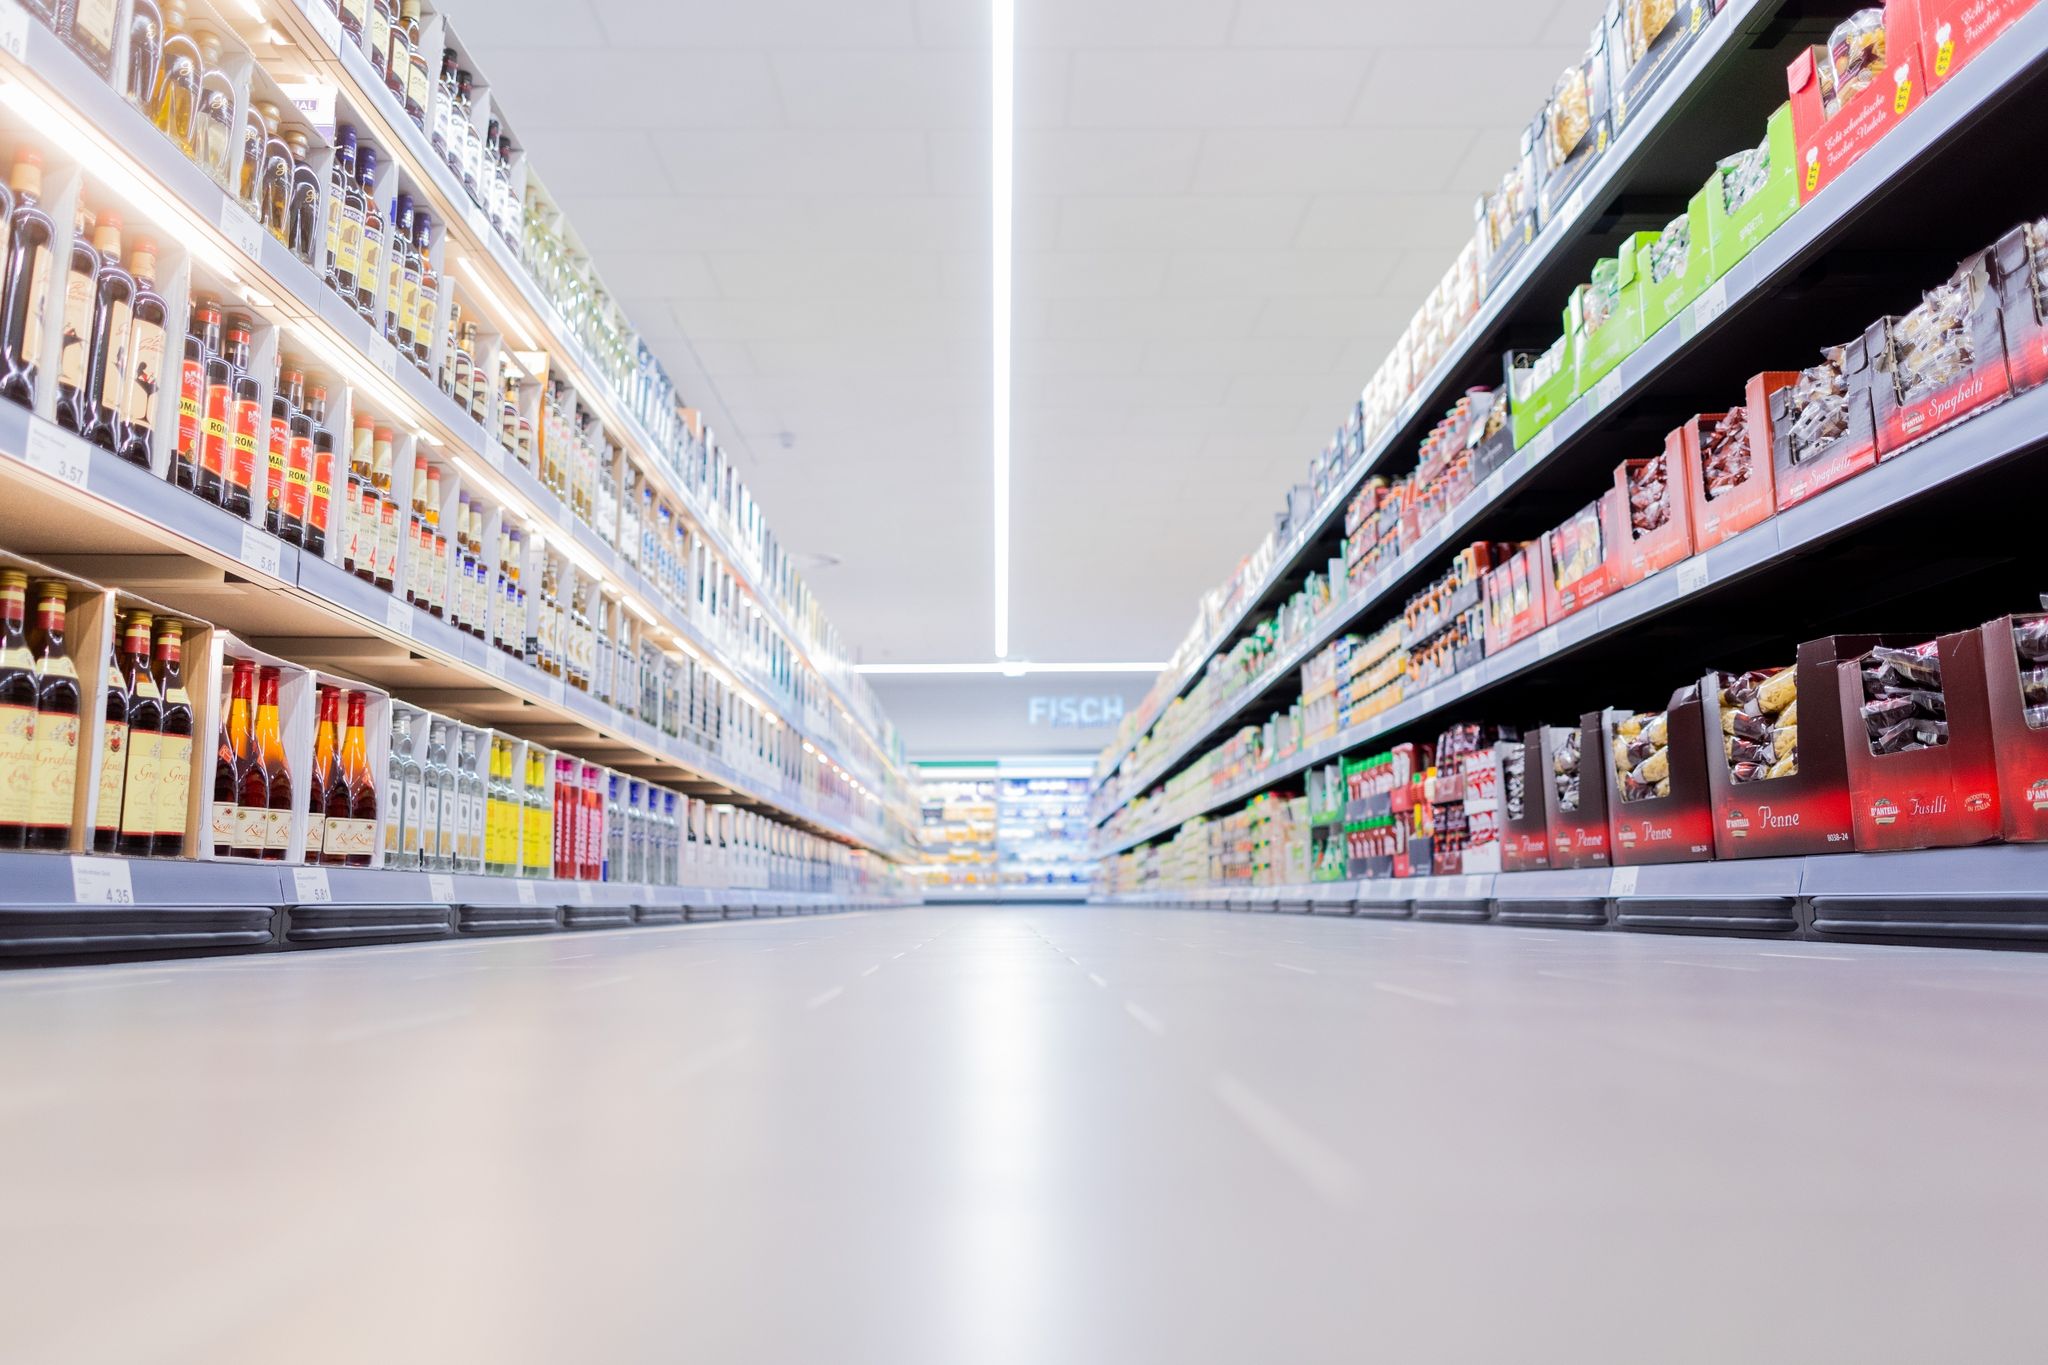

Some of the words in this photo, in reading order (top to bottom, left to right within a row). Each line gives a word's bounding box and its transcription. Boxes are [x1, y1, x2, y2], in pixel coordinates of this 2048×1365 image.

[1928, 377, 1984, 418] Spaghetti
[59, 461, 83, 484] 3.57
[1809, 456, 1851, 488] Spaghetti
[1028, 696, 1124, 724] FISCH
[1870, 806, 1899, 817] D'ANTELLI
[1909, 796, 1947, 815] Fusilli
[1758, 806, 1800, 829] Penne
[1576, 828, 1603, 848] Penne
[1642, 821, 1673, 842] Penne
[106, 888, 130, 904] 4.35
[314, 888, 329, 901] 5.81
